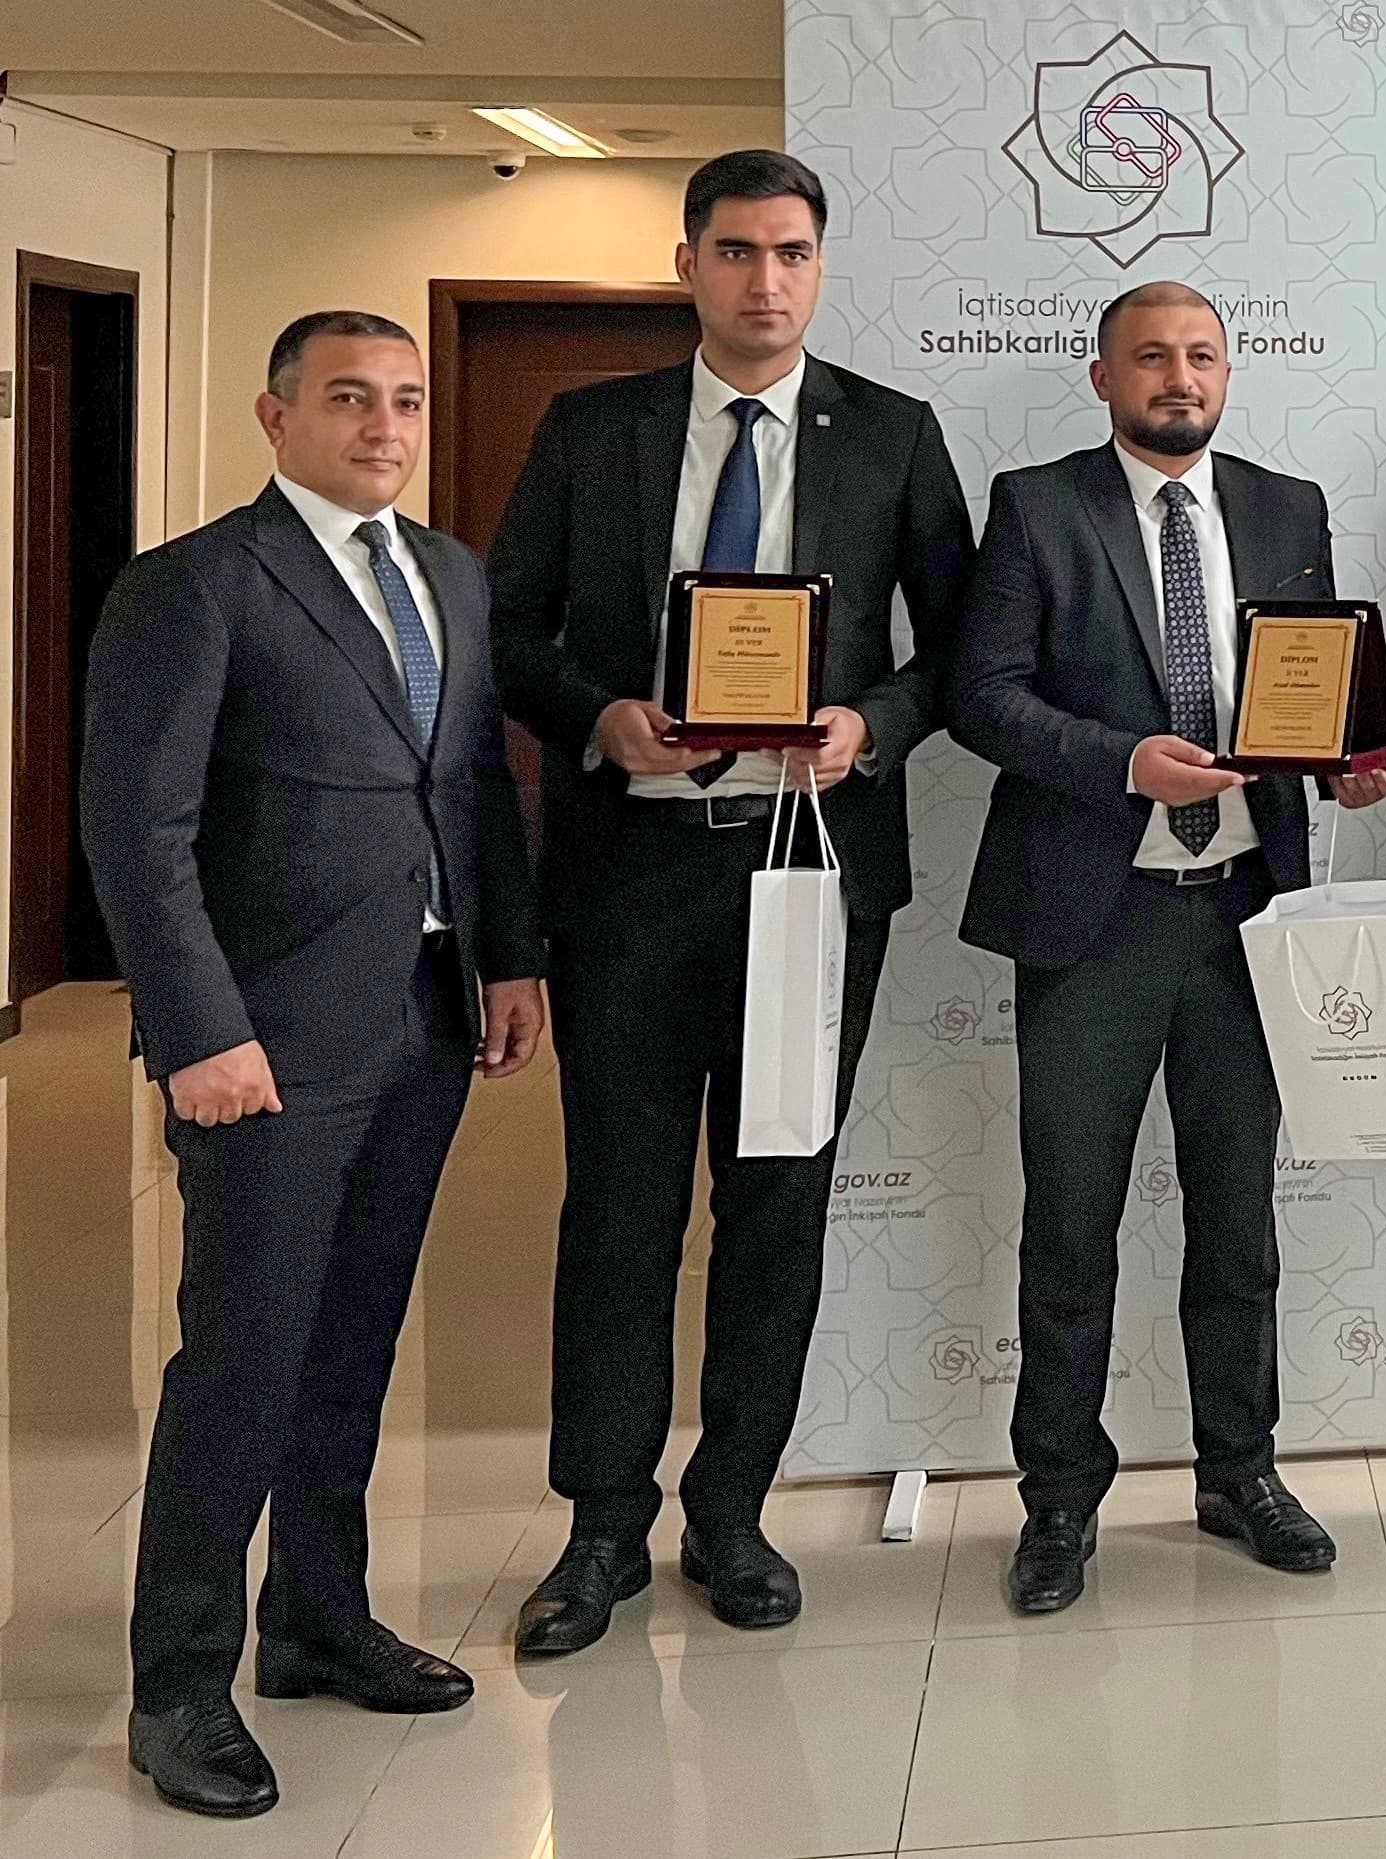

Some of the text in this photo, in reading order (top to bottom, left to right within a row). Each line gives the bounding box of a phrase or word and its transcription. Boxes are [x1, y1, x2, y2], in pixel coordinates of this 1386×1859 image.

[958, 288, 1289, 322] İqtisadiyy liyinin
[920, 329, 1326, 359] Sahibkarlığı Fondu
[833, 1172, 912, 1194] gov.az
